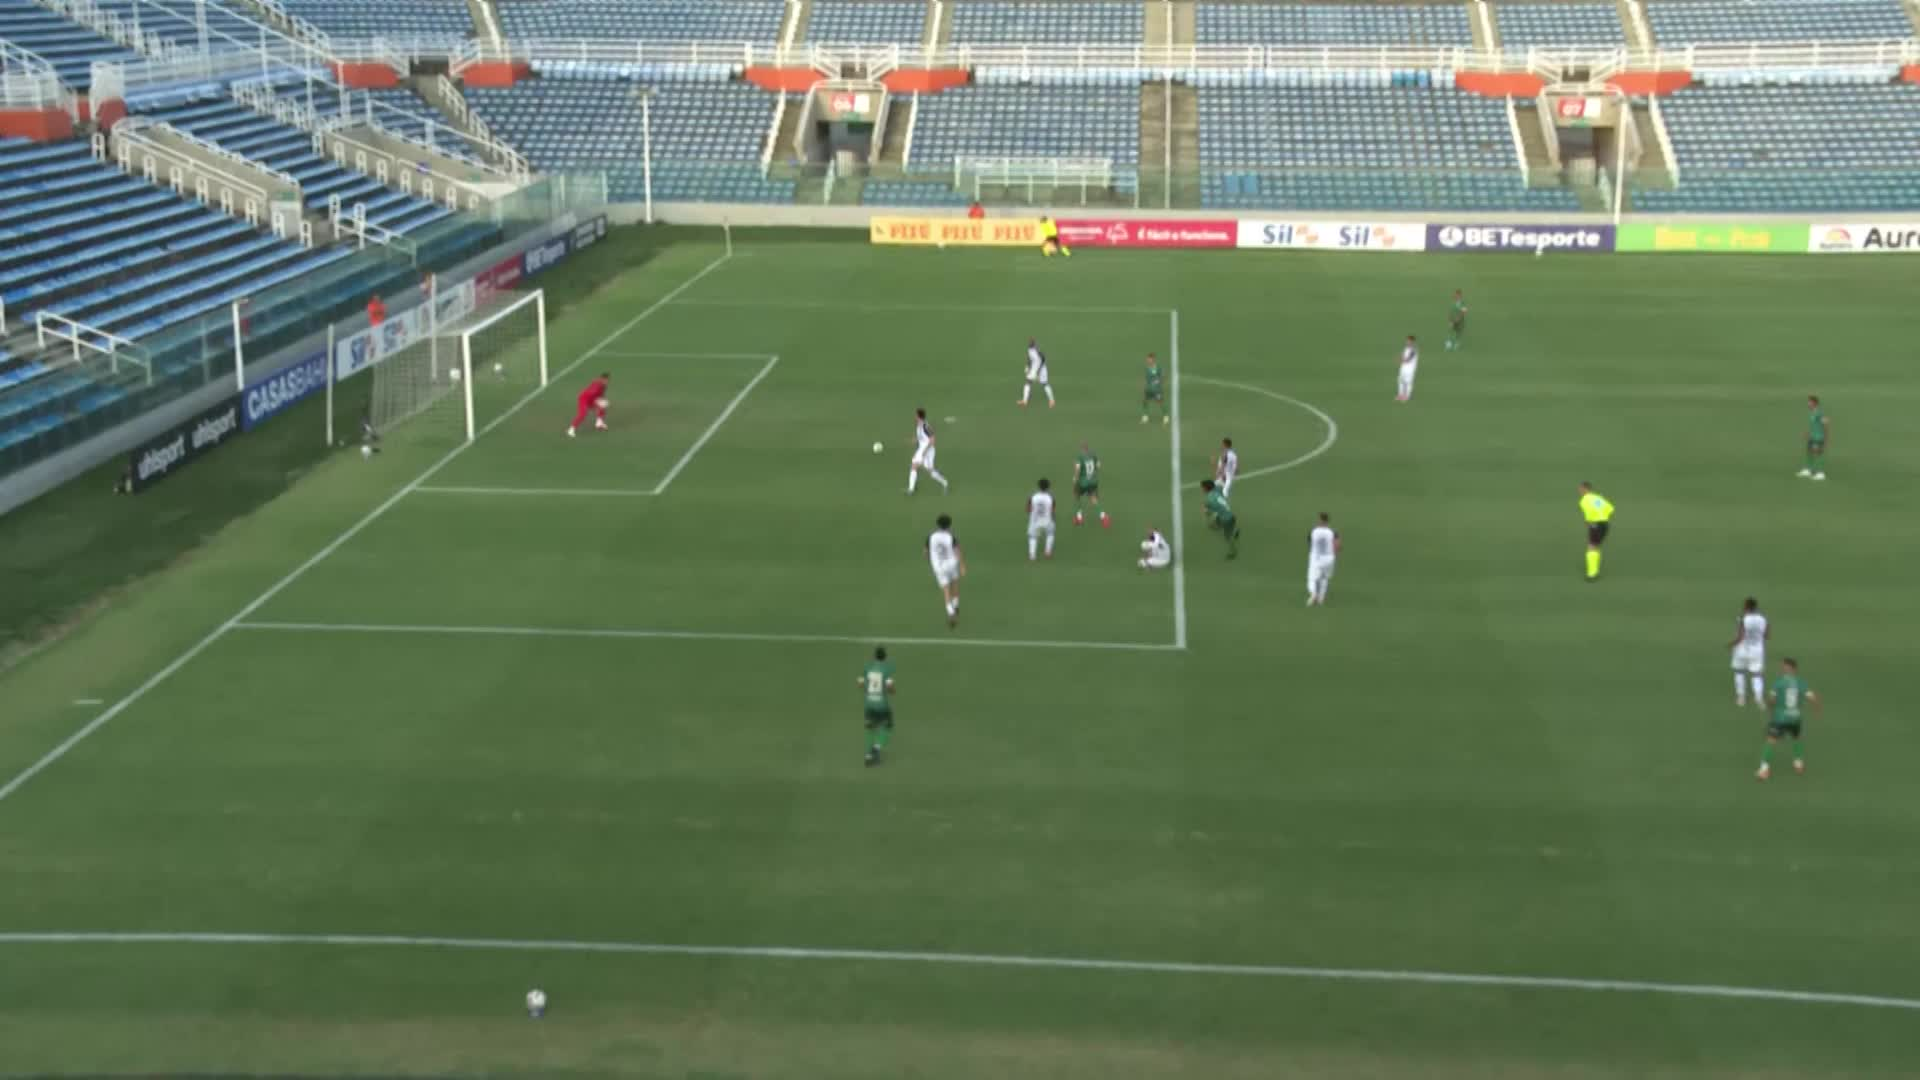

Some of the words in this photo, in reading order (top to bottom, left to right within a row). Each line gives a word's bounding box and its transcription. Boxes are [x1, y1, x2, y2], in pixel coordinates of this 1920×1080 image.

[1263, 224, 1293, 244] Sil
[1339, 225, 1369, 246] Sil
[1465, 227, 1601, 249] BETesporte
[1862, 227, 1920, 248] Aur
[138, 435, 187, 481] uhlsport
[191, 407, 238, 449] uhlsport
